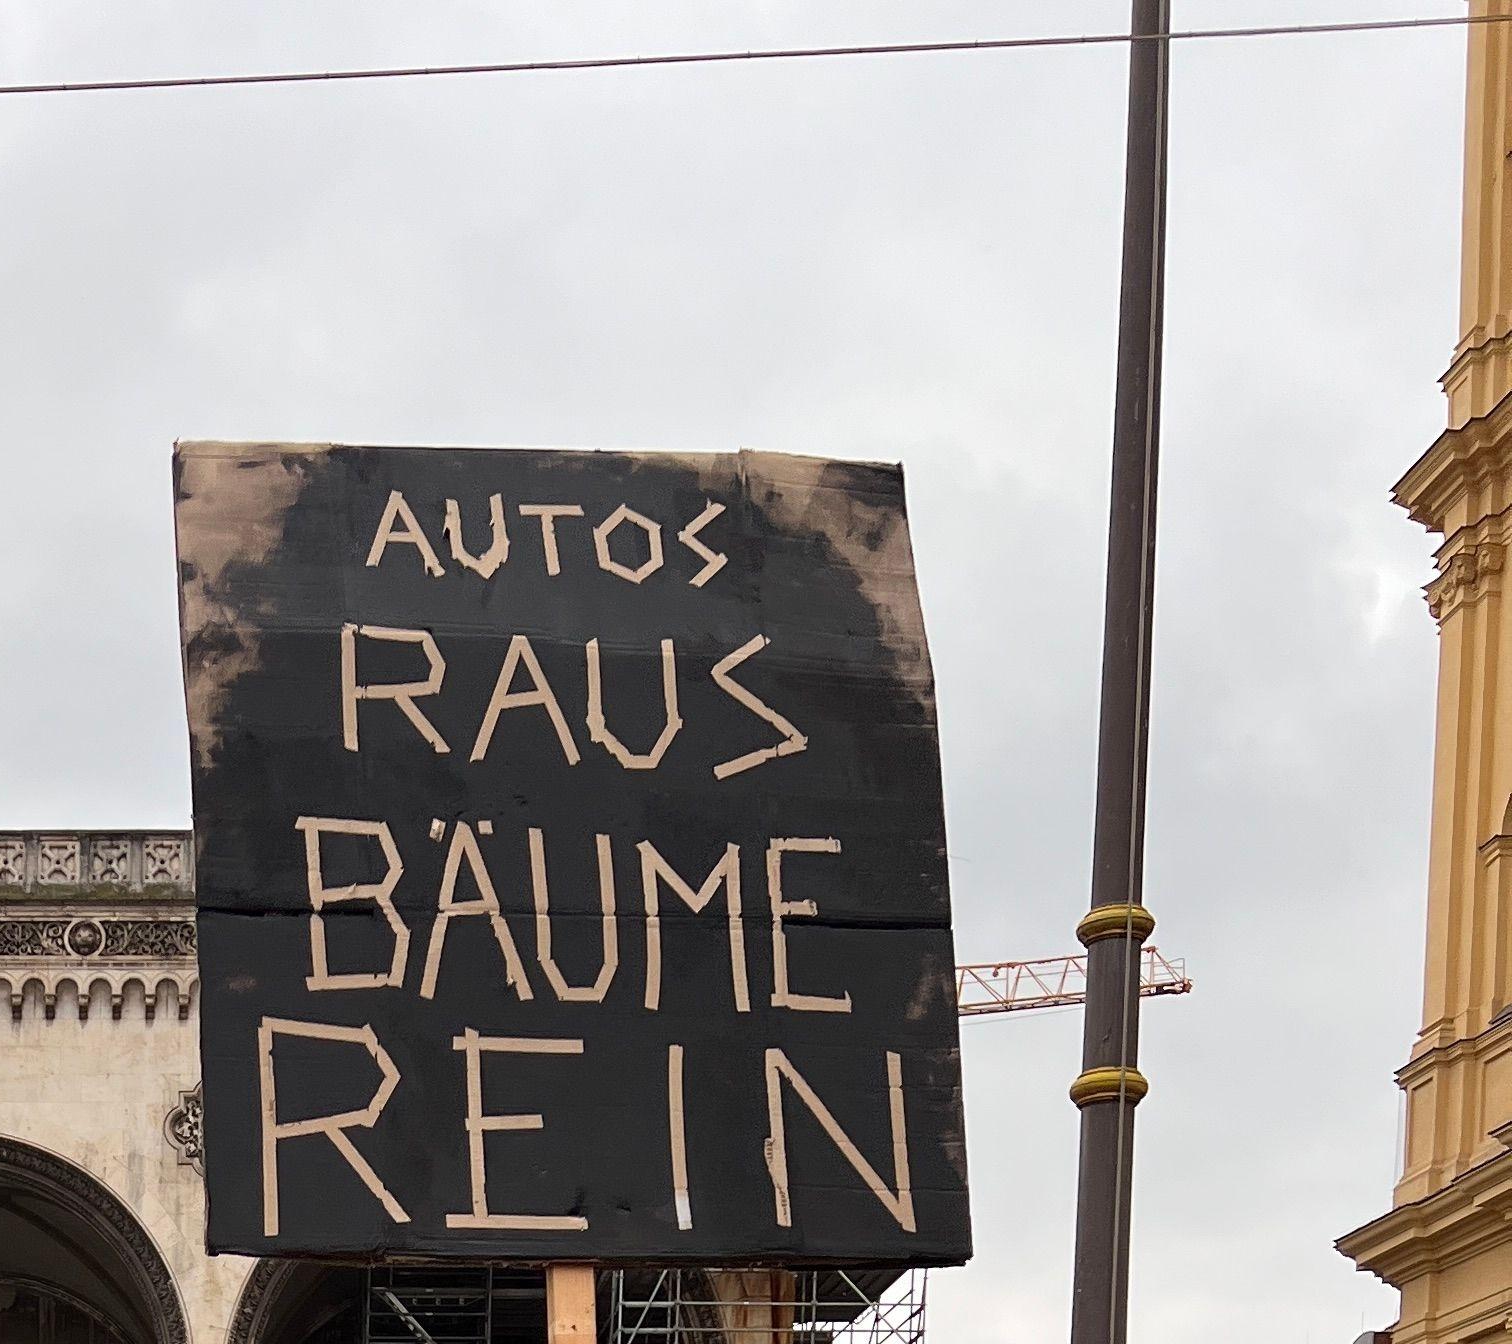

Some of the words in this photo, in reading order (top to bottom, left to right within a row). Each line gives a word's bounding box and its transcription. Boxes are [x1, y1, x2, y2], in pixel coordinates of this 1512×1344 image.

[366, 490, 728, 587] AUTOS
[340, 623, 808, 780] RAUS
[294, 815, 852, 1013] BÄUME
[257, 1016, 917, 1237] REIN
